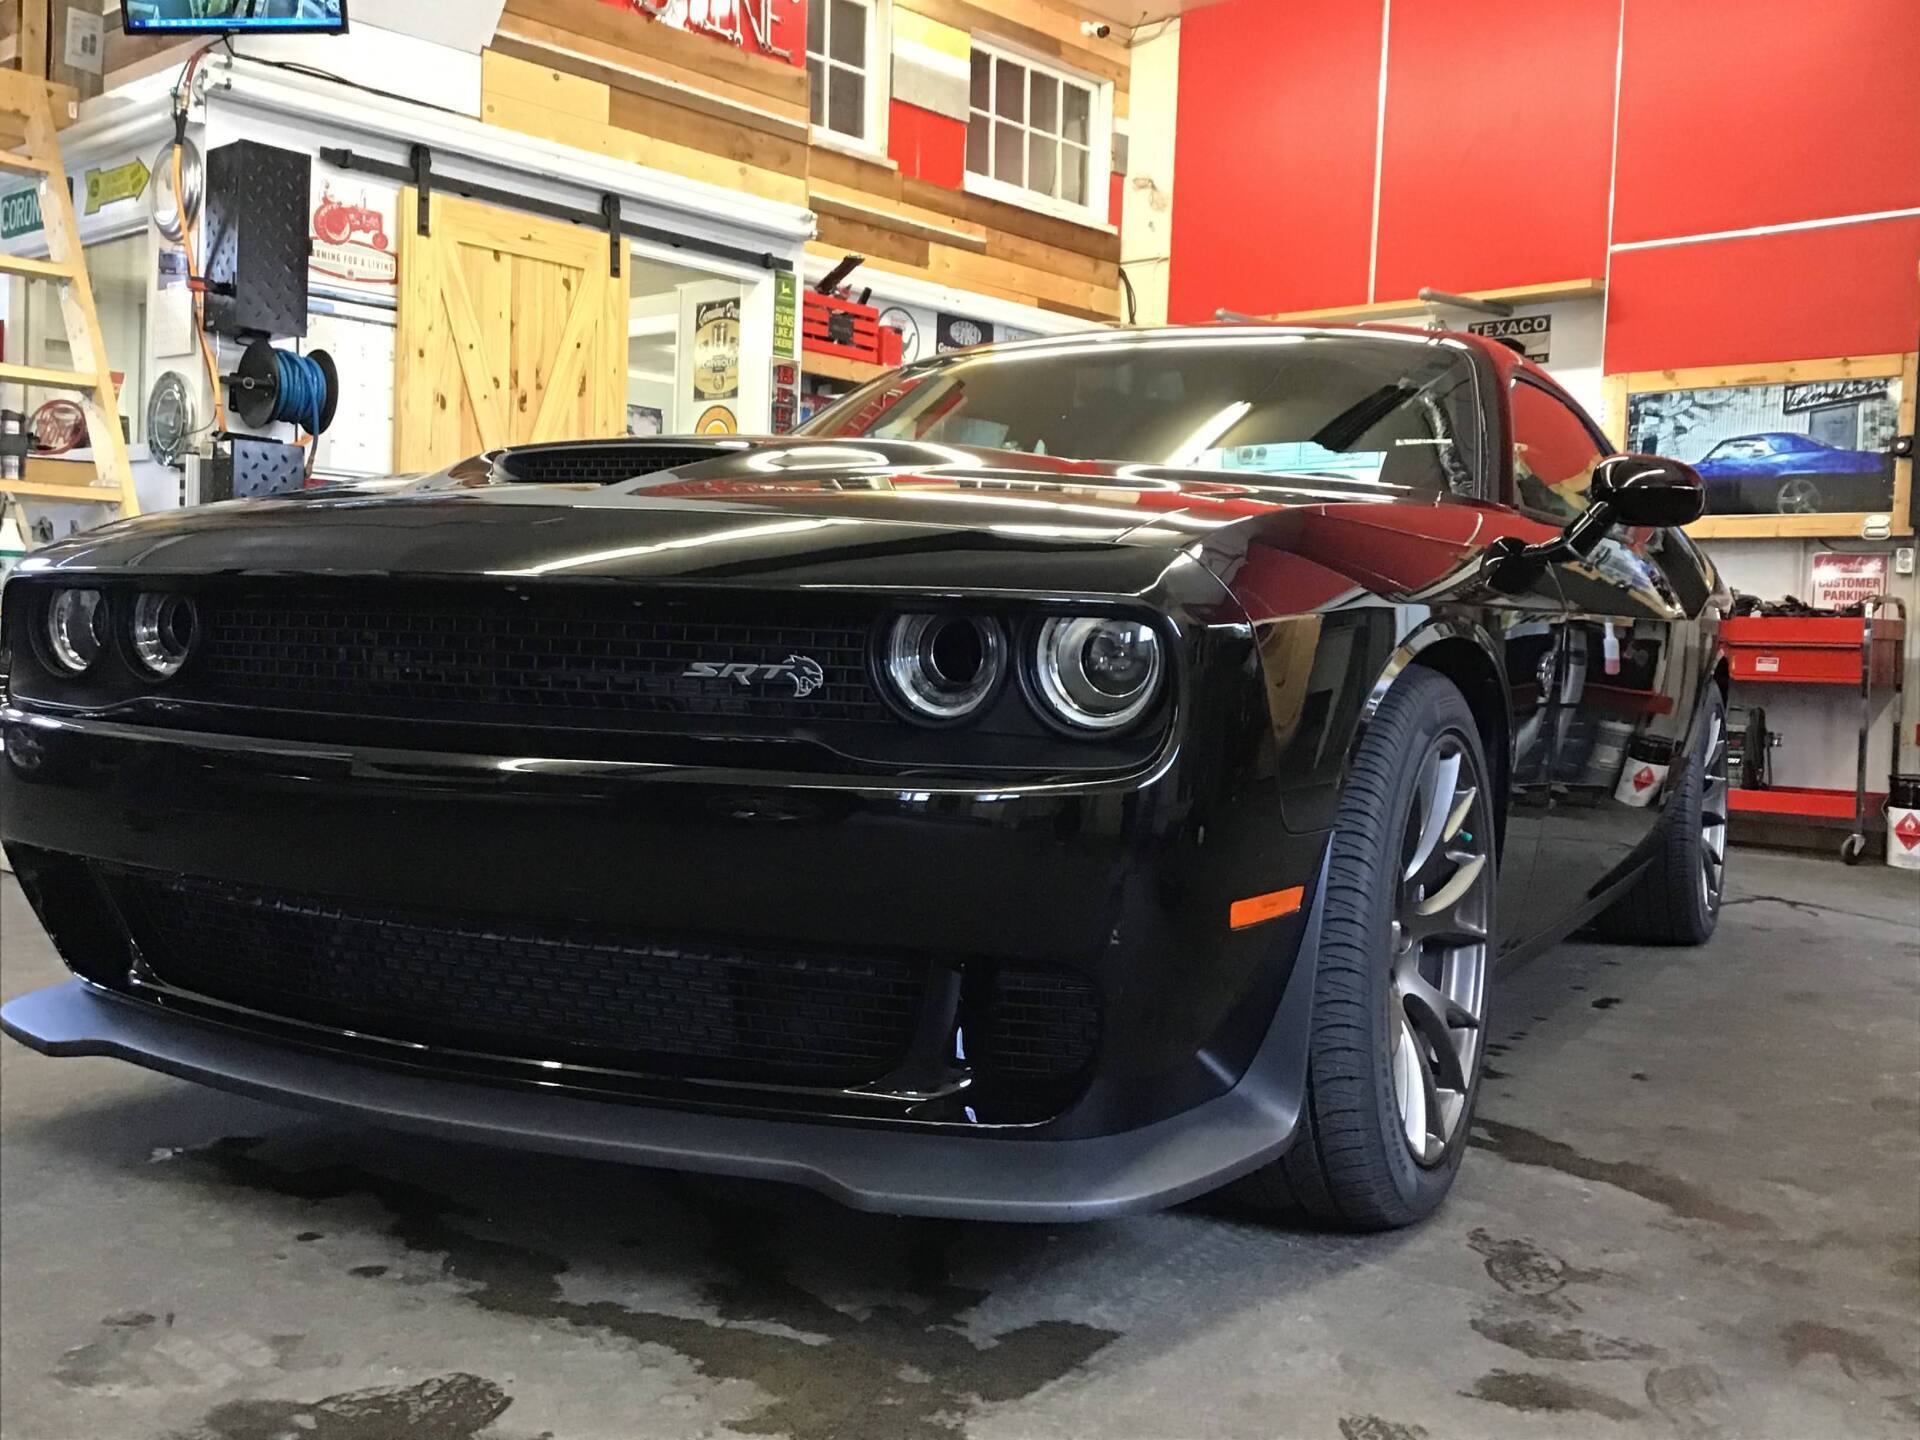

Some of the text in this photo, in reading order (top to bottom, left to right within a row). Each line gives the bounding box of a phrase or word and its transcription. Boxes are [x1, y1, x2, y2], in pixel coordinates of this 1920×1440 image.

[775, 314, 794, 327] RUNS
[774, 326, 788, 338] LIKE
[1471, 317, 1547, 337] TEXACO
[1819, 577, 1881, 588] CUSTOMER
[1823, 590, 1874, 601] PARKING
[682, 662, 795, 686] SRT
